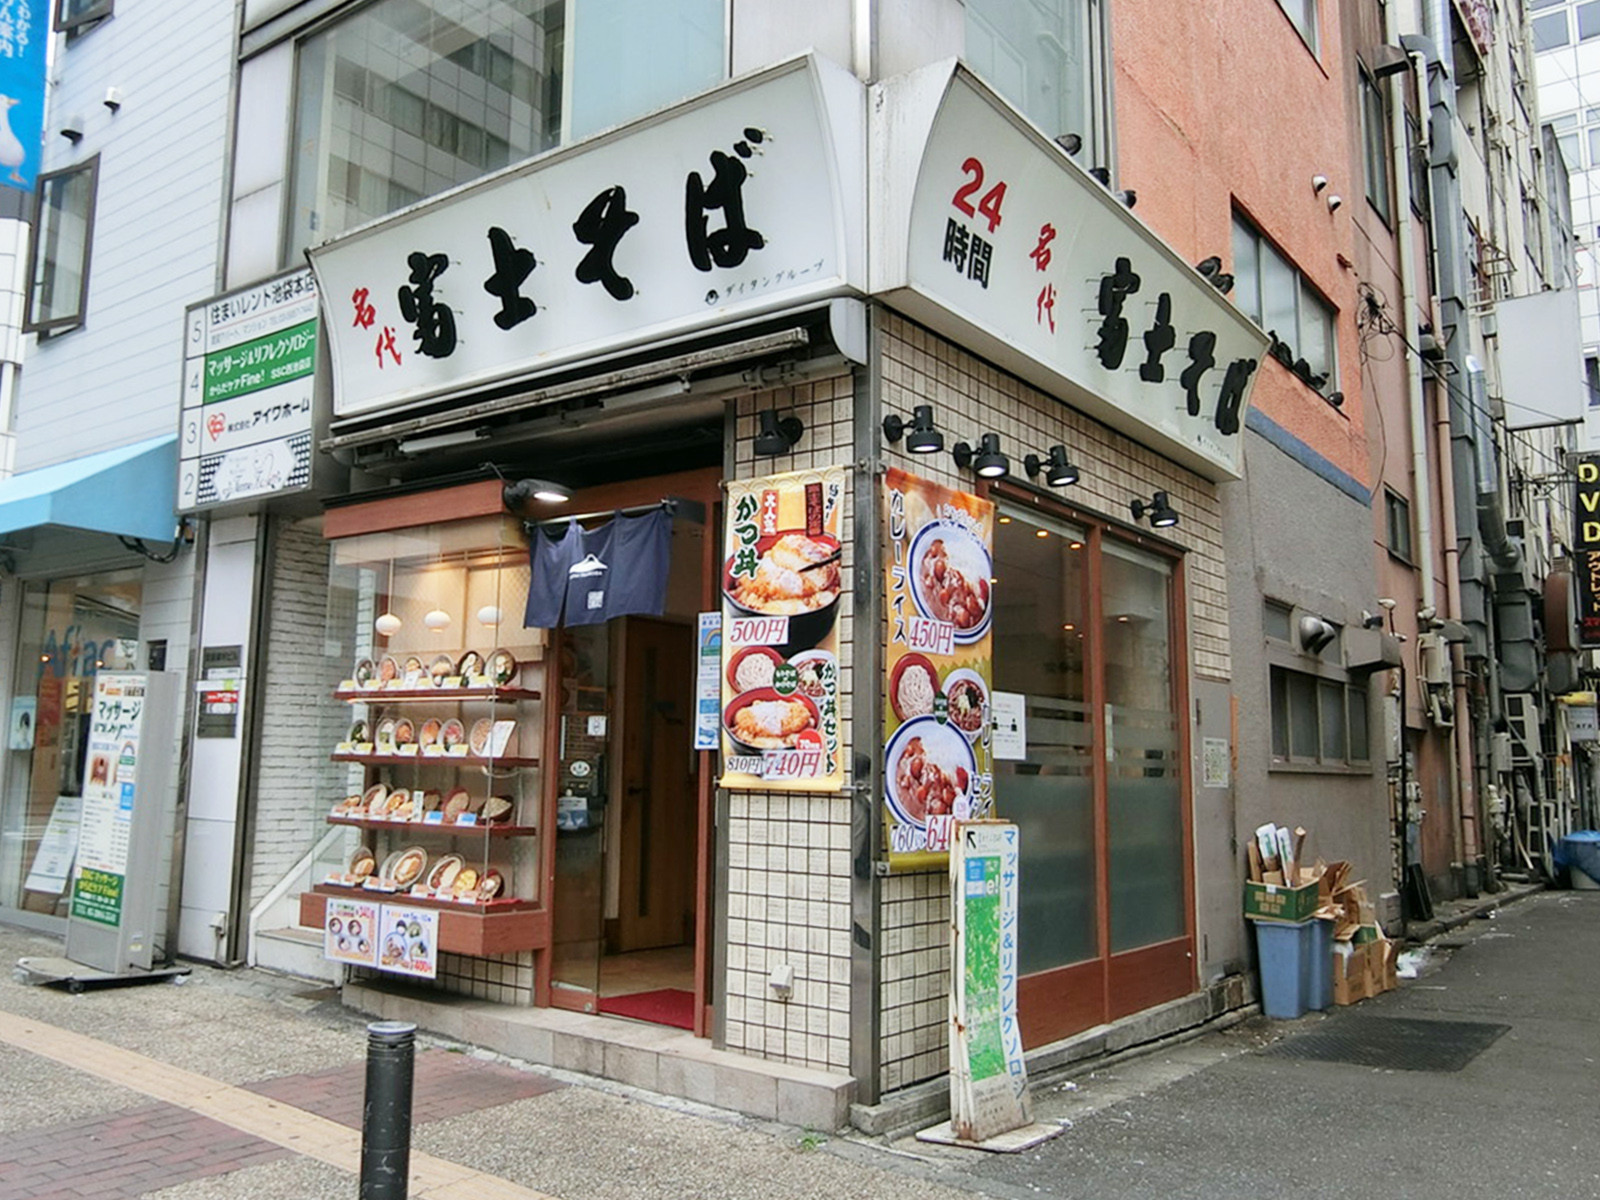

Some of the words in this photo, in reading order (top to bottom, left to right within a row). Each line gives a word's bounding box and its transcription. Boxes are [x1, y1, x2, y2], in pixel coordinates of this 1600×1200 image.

[951, 157, 1007, 234] 24
[352, 288, 402, 368] 名代
[398, 127, 766, 358] 富士そば
[943, 217, 993, 289] 時間
[192, 321, 201, 343] 5
[1029, 222, 1057, 335] 名代
[1096, 257, 1257, 435] 富士そば
[190, 372, 199, 392] 4
[252, 396, 310, 426] アイワホーム
[186, 422, 197, 444] 3
[184, 473, 195, 495] 2
[733, 493, 758, 578] かつ丼
[890, 490, 906, 643] カレーライス
[731, 619, 787, 643] 500円
[910, 620, 953, 653] 450円
[99, 701, 142, 720] マッサージ
[823, 662, 837, 774] かつ丼セット
[727, 756, 761, 774] 810円
[766, 751, 821, 777] 740円
[1002, 830, 1027, 1121] マッサージ&リフレクソロジー
